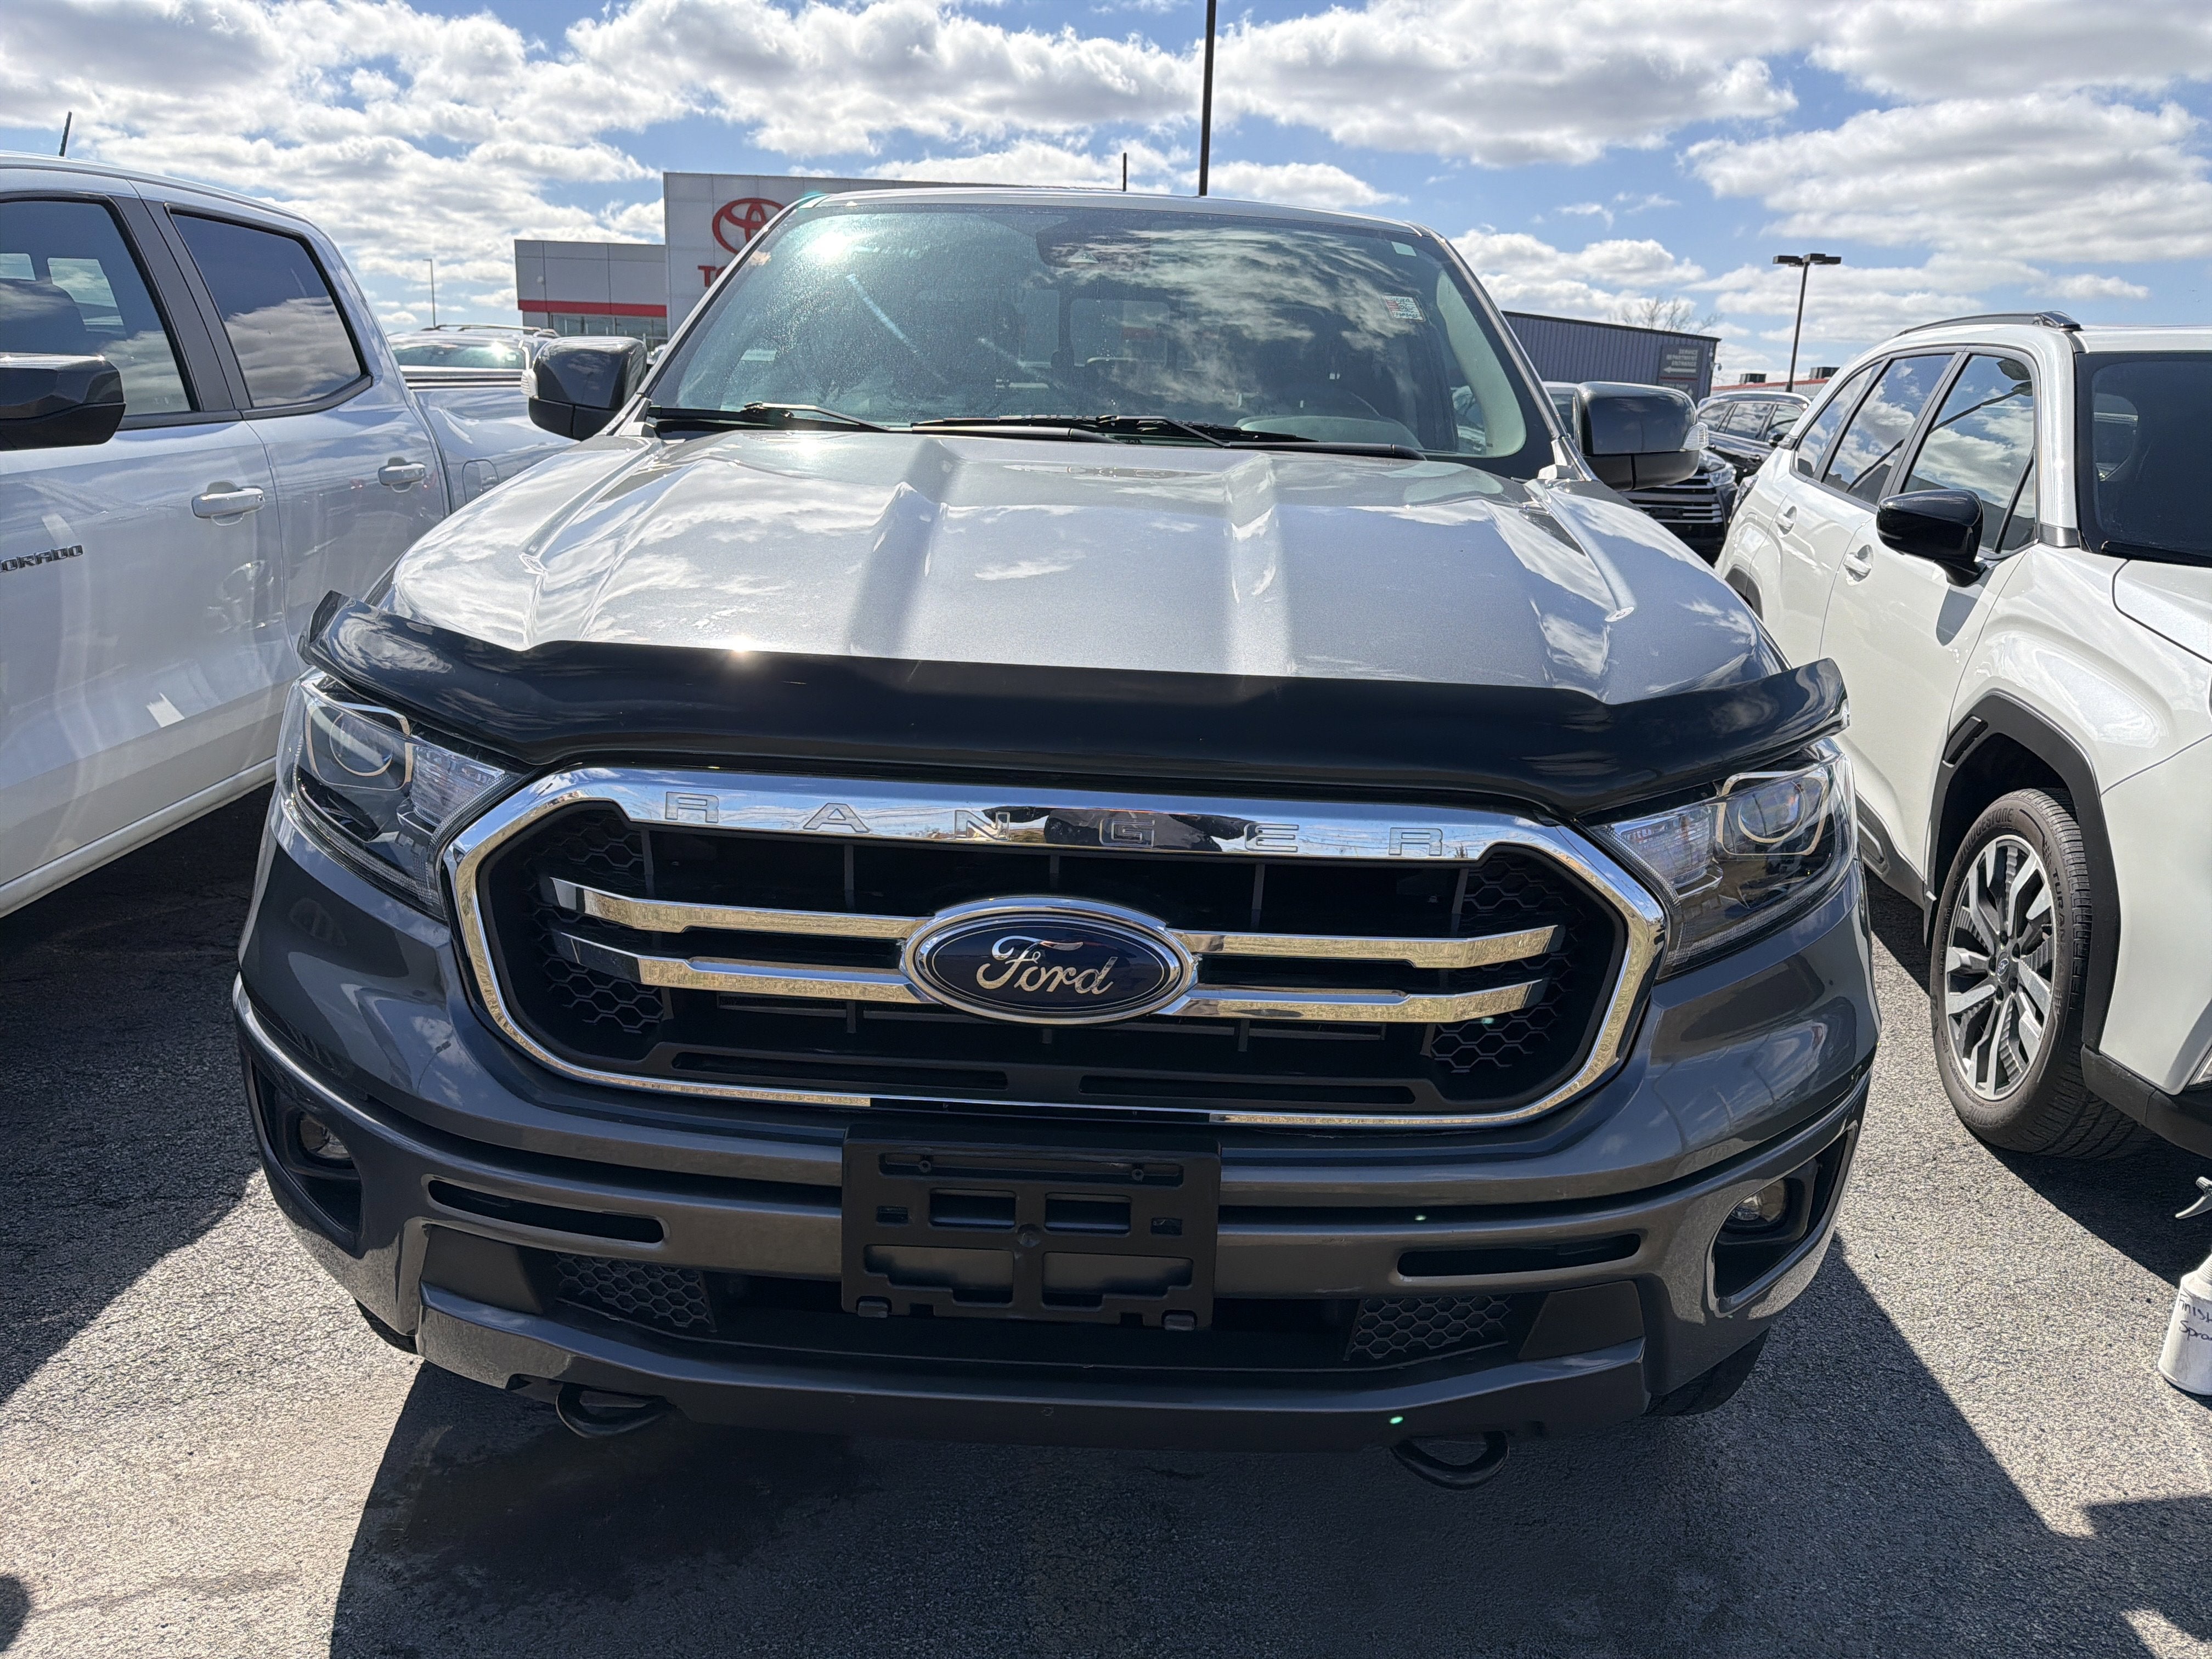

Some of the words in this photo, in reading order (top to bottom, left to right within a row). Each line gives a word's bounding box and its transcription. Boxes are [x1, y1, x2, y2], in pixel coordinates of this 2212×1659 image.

[665, 791, 1443, 857] RANGER
[976, 935, 1119, 995] Ford
[2179, 1320, 2212, 1341] Spra
